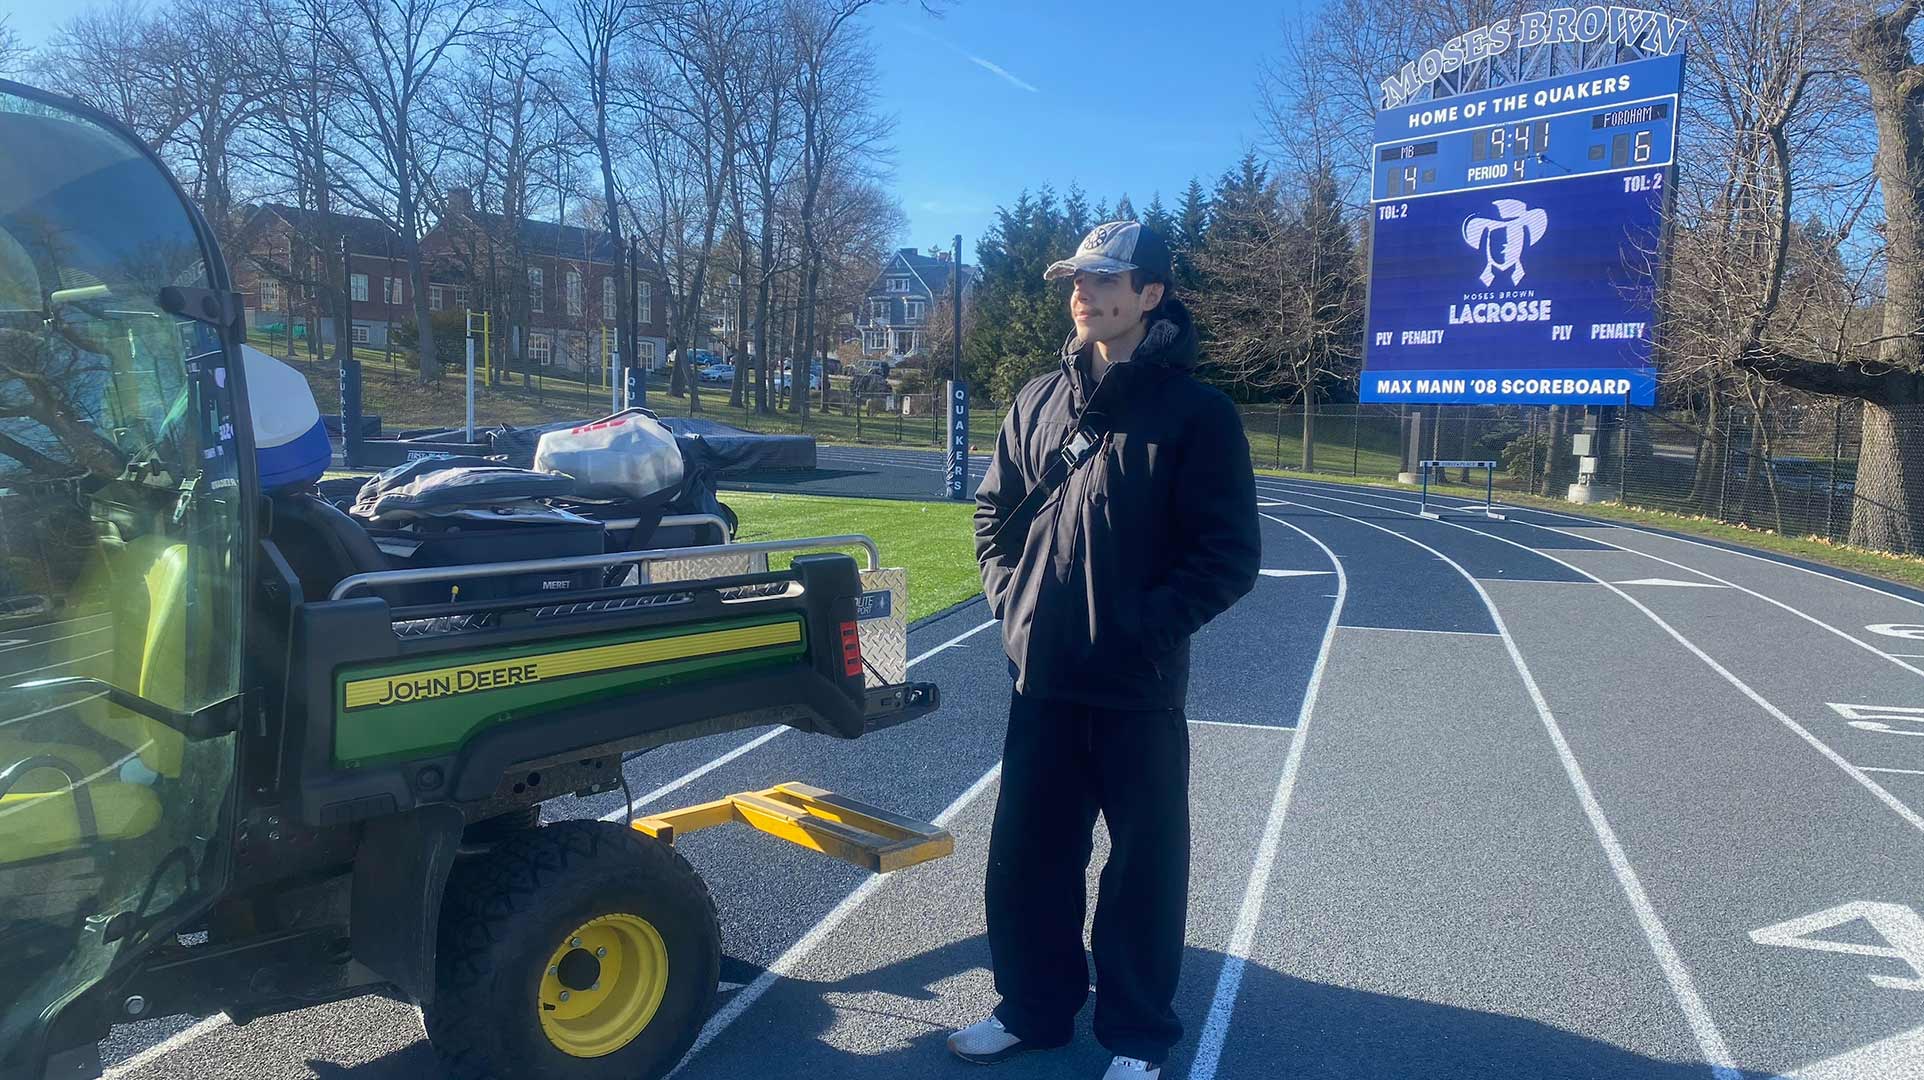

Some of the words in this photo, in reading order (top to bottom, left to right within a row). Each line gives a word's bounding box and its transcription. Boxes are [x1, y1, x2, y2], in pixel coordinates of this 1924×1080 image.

[1381, 19, 1511, 110] MOSES
[1518, 6, 1688, 56] BROWN
[1409, 106, 1458, 128] HOME
[1463, 101, 1487, 118] OF
[1492, 94, 1528, 113] THE
[1534, 75, 1630, 107] QUAKERS
[1604, 106, 1652, 128] FORDHAM
[1401, 145, 1415, 159] MB
[1634, 131, 1650, 162] 6
[1404, 167, 1417, 190] 4
[1467, 164, 1508, 182] PERIOD
[1514, 159, 1524, 178] 4
[1624, 175, 1650, 193] TOL:
[1653, 173, 1663, 190] 2
[1379, 205, 1399, 220] TOL:
[1401, 203, 1408, 218] 2
[1463, 292, 1495, 300] MOSES
[1499, 290, 1534, 299] BROWN
[1449, 300, 1552, 324] LACROSSE
[1376, 332, 1393, 346] PLY
[1401, 330, 1444, 345] PENALTY
[1552, 325, 1573, 341] PLY
[1591, 323, 1645, 340] PENALTY
[1377, 380, 1412, 394] MAX
[1416, 380, 1465, 394] MANN
[1470, 379, 1497, 394] '08
[1501, 379, 1630, 395] SCOREBOARD
[954, 390, 965, 490] QUAKERS
[543, 580, 570, 590] MERET
[379, 676, 450, 703] JOHN
[457, 664, 538, 690] DEERE
